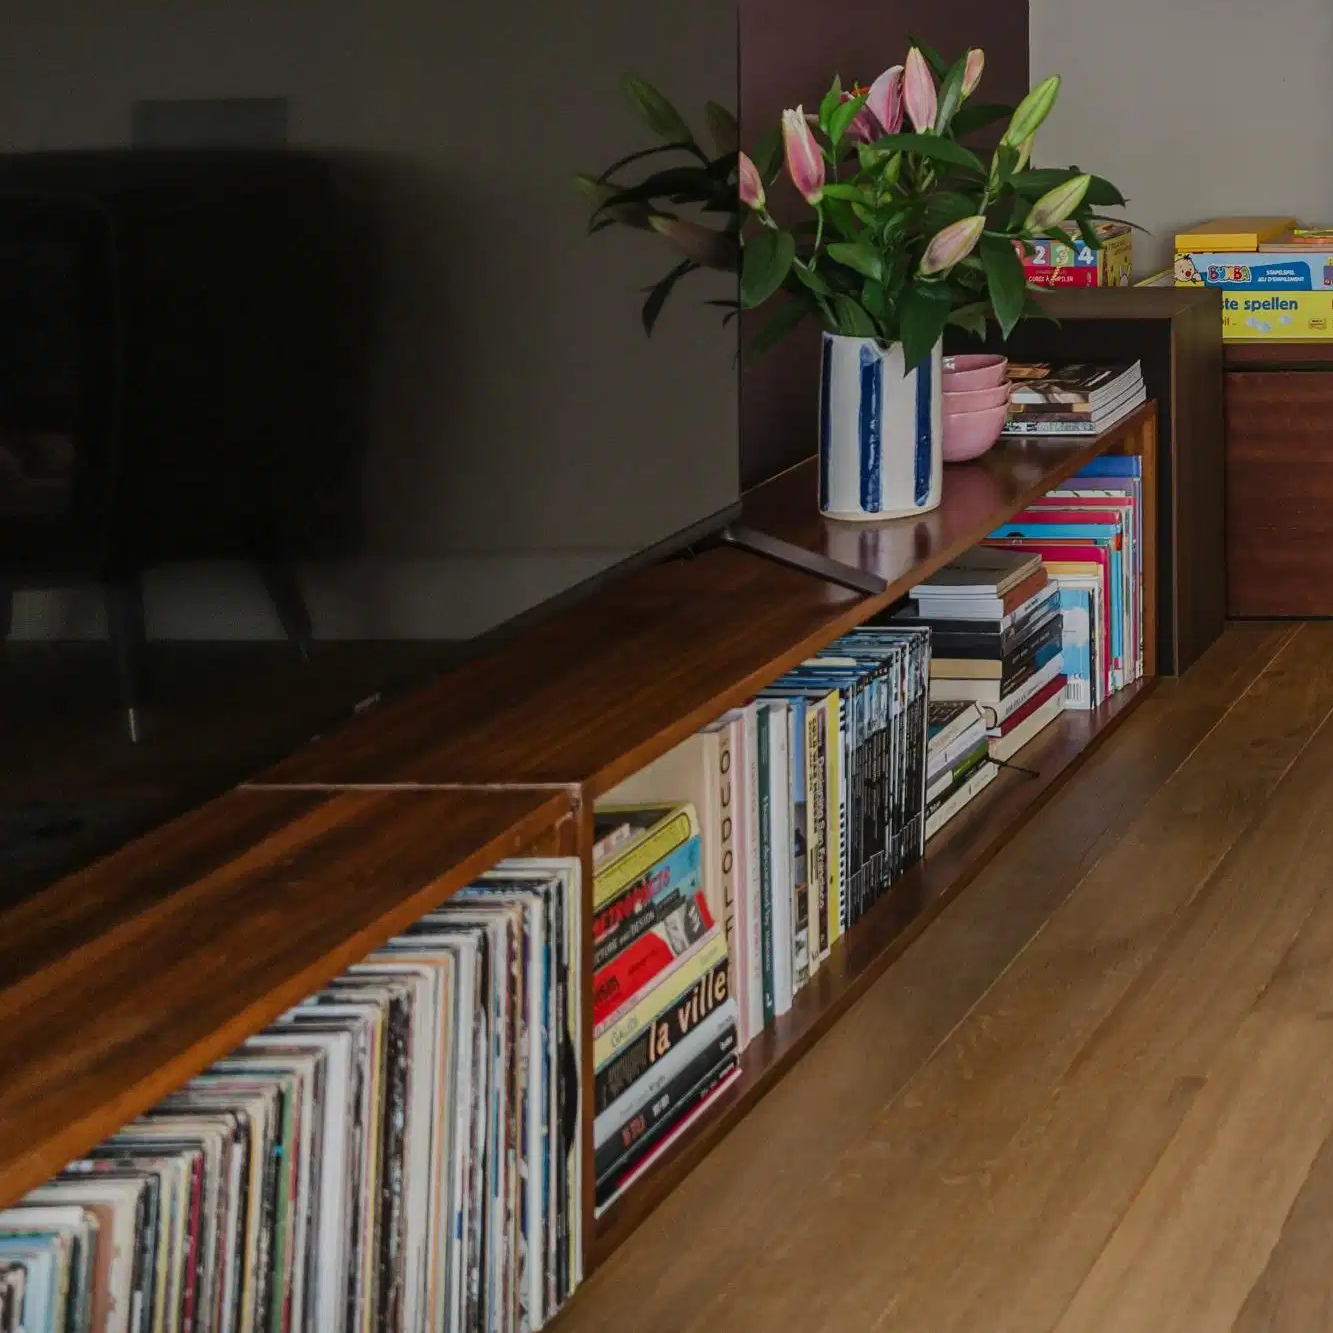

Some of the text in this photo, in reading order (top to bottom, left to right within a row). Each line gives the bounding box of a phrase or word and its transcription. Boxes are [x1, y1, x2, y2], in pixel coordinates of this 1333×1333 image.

[1032, 245, 1094, 265] 2 3 4
[1208, 265, 1251, 282] BUMBA
[1244, 296, 1298, 312] spellen
[648, 969, 726, 1062] la ville
